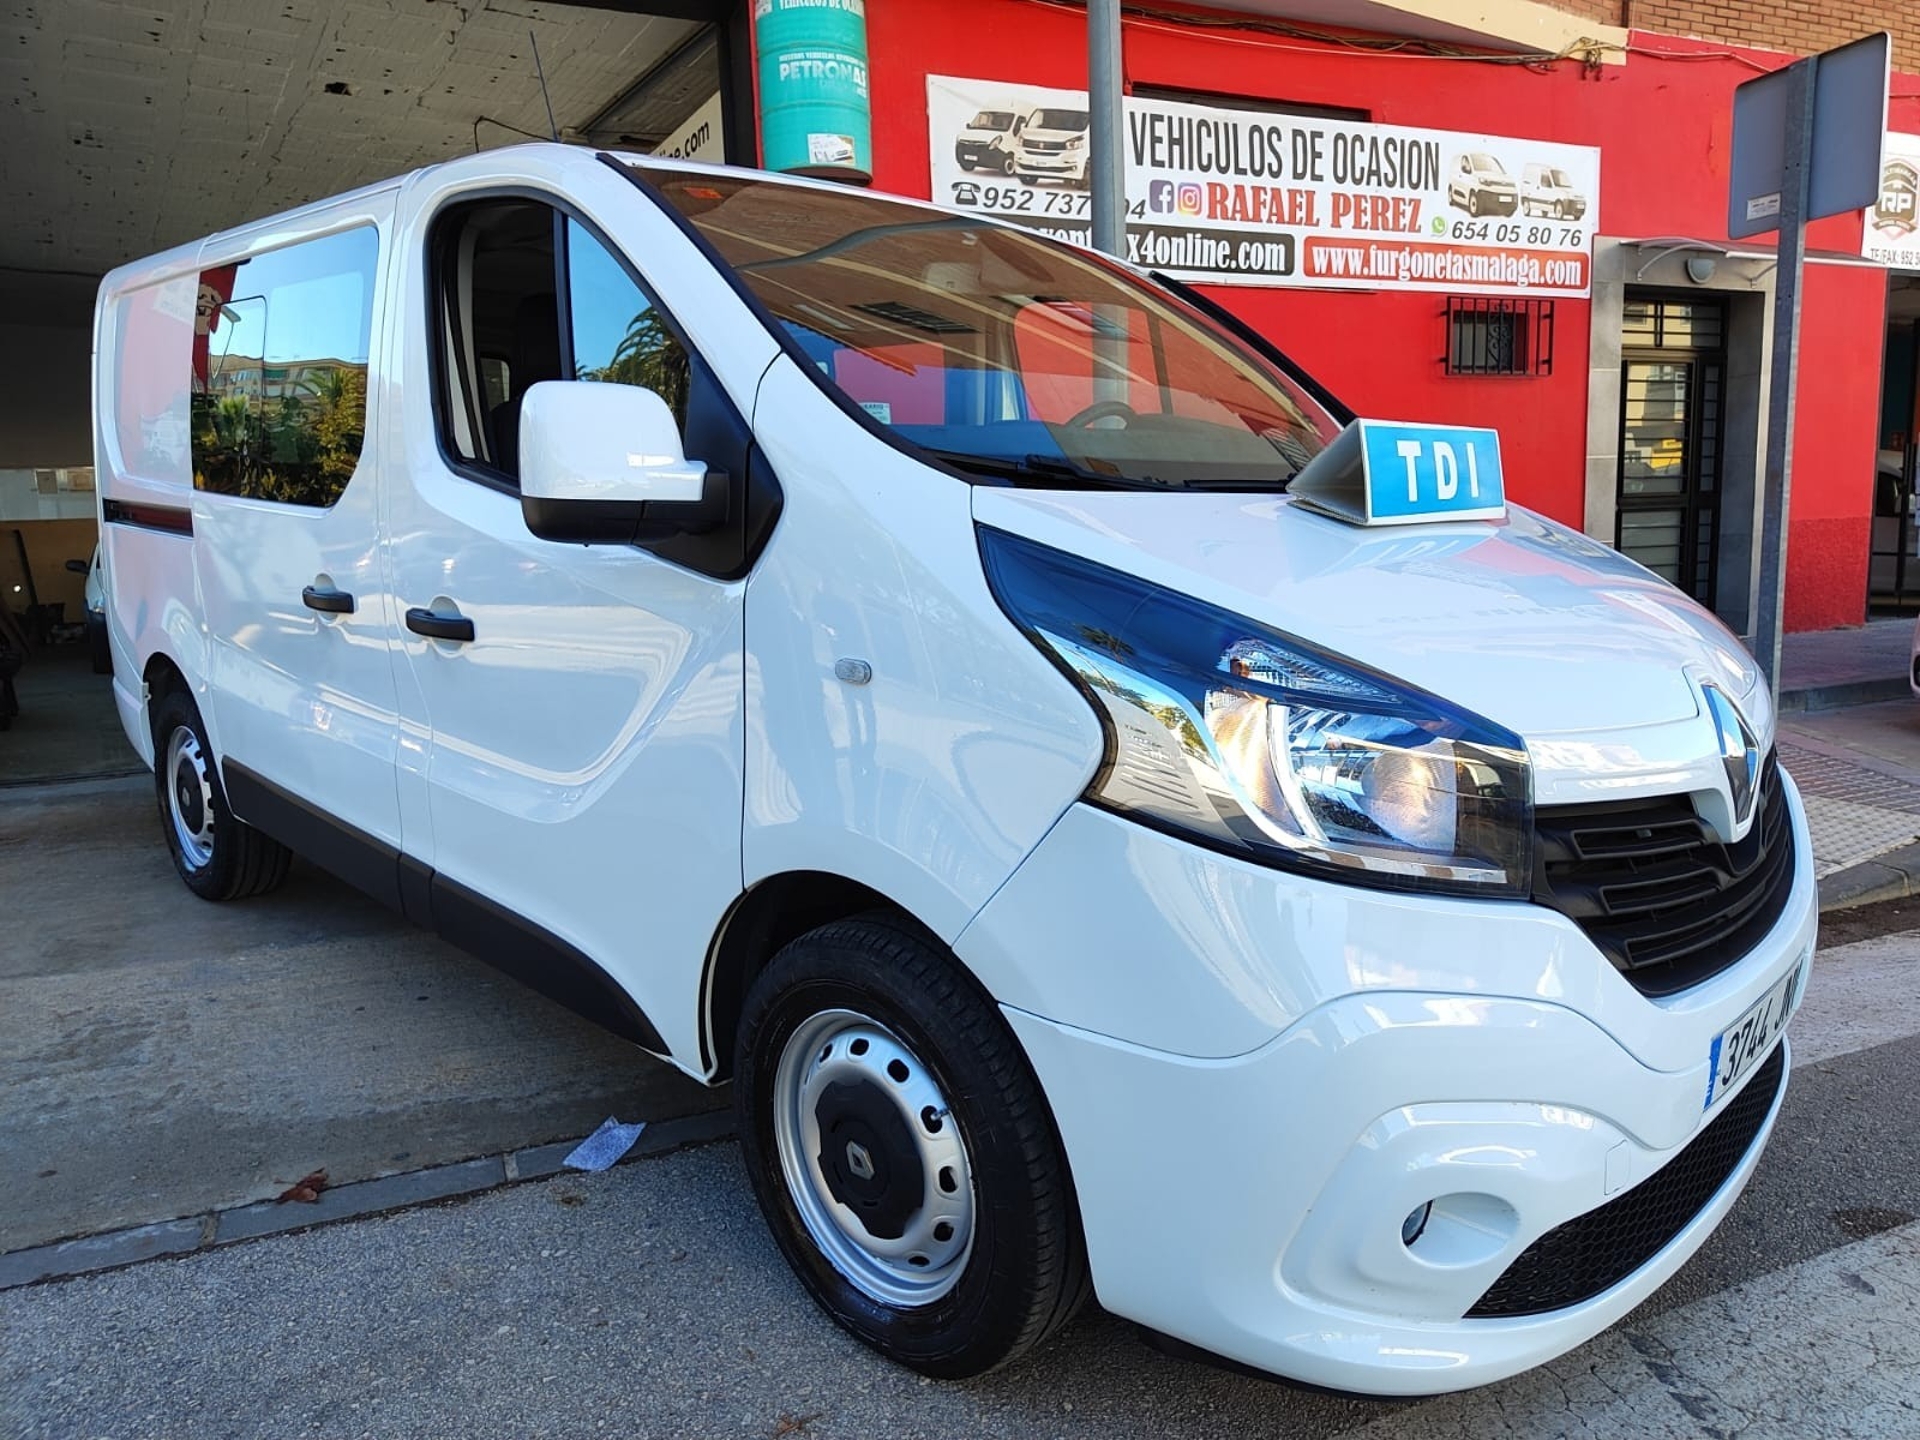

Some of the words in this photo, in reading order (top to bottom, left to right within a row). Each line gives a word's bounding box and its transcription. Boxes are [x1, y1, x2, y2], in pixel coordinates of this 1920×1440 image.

[1129, 111, 1282, 179] VEHICULOS
[1291, 128, 1324, 182] DE
[1332, 131, 1440, 192] OCASION
[982, 187, 1034, 211] 952
[1043, 191, 1091, 216] 737
[1206, 182, 1320, 227] RAFAEL
[1330, 192, 1422, 233] PEREZ
[1451, 221, 1489, 241] 654
[1496, 224, 1520, 243] 05
[1527, 226, 1551, 246] 80
[1559, 228, 1582, 247] 76
[1311, 244, 1581, 287] www.furgonetasmalaga.com
[1721, 997, 1773, 1086] 3744
